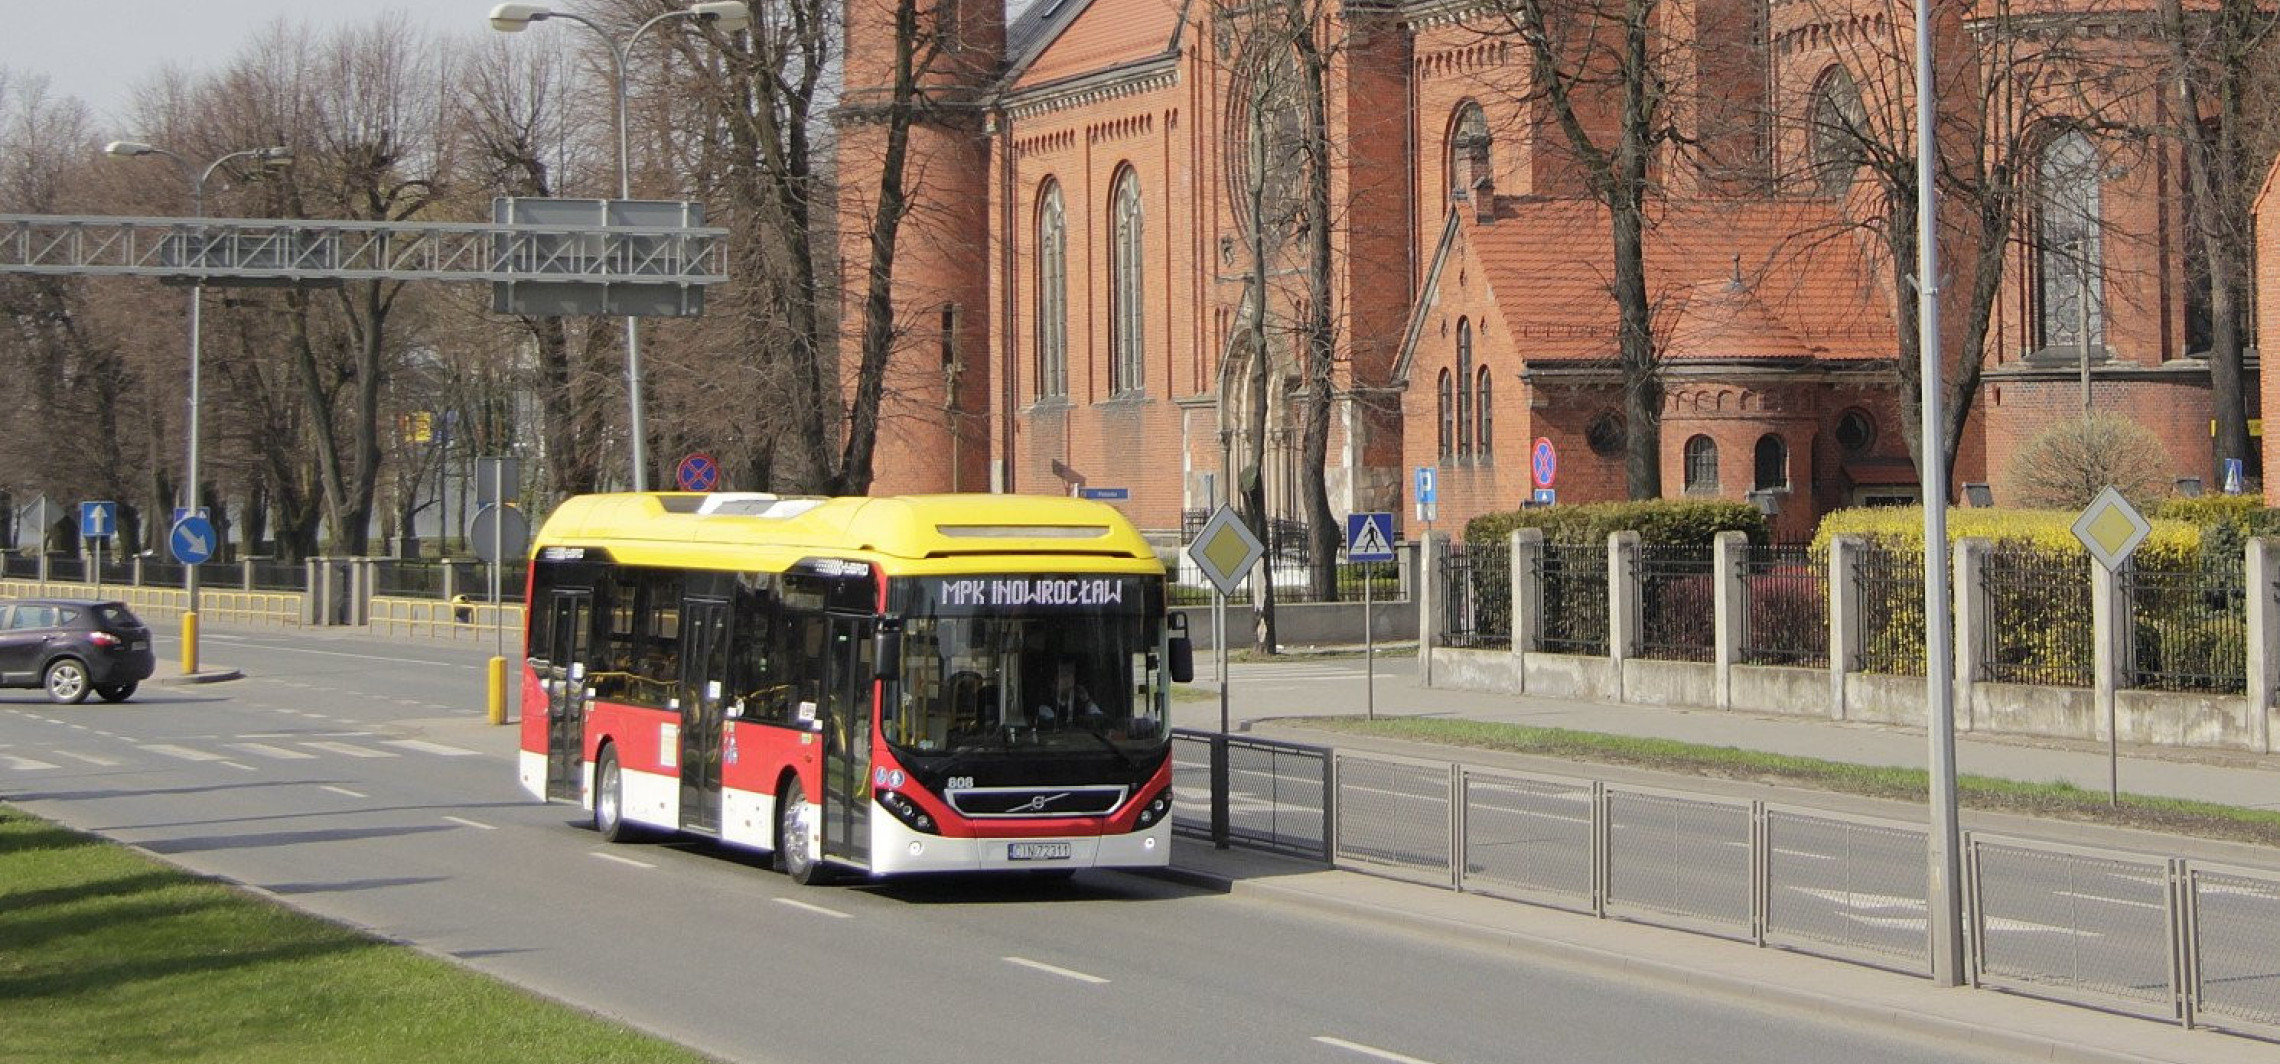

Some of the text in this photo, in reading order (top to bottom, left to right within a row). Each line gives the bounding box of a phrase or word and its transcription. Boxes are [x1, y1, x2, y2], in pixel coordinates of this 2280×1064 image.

[942, 579, 1123, 605] MPK INOWROCŁAW
[948, 776, 974, 789] 808
